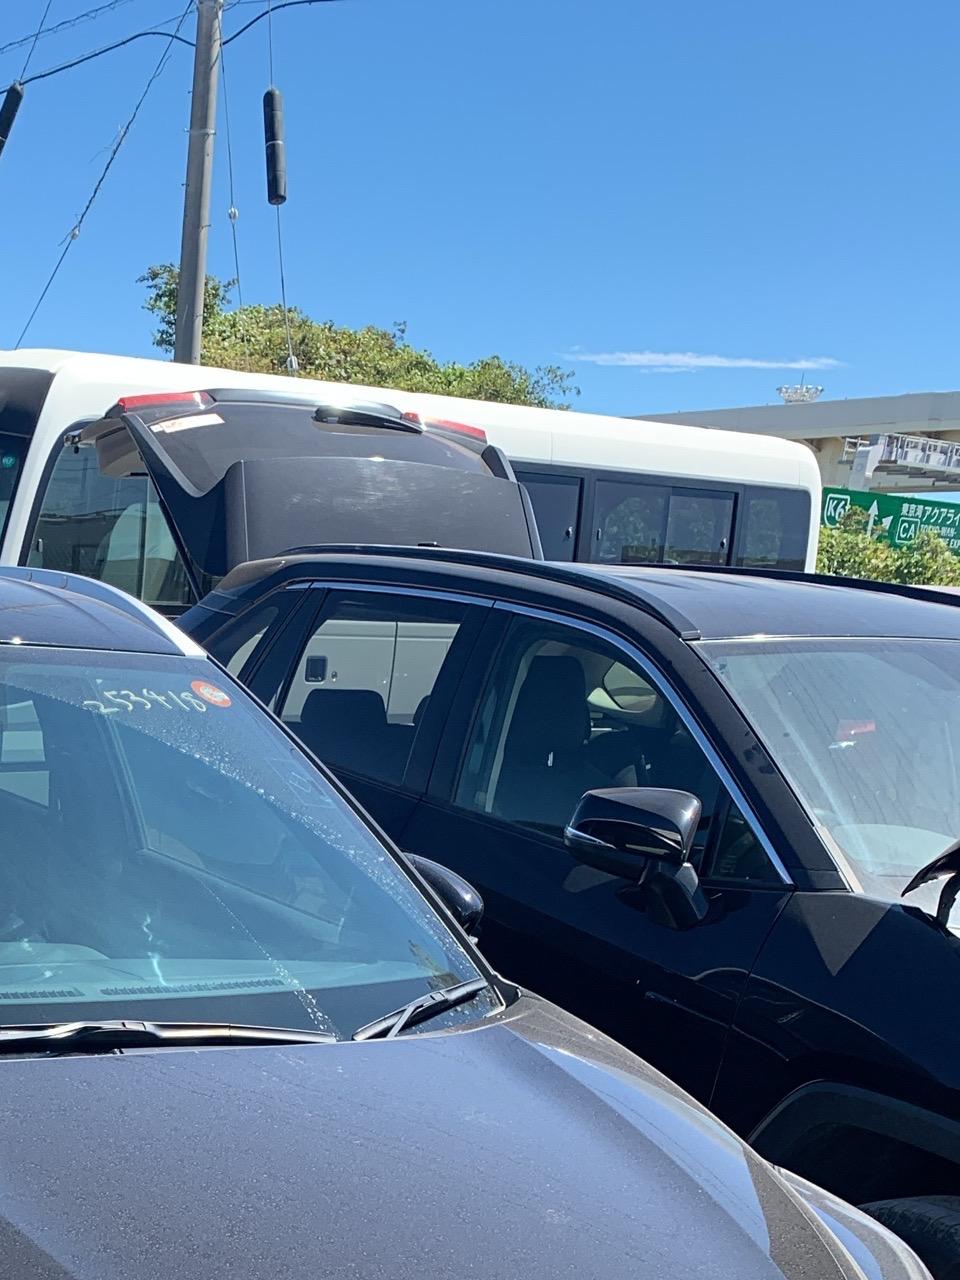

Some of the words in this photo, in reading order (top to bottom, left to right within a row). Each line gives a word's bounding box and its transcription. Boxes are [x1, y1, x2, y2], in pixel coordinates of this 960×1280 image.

[827, 499, 845, 521] K6
[900, 523, 915, 538] CA
[83, 688, 207, 713] 253418
